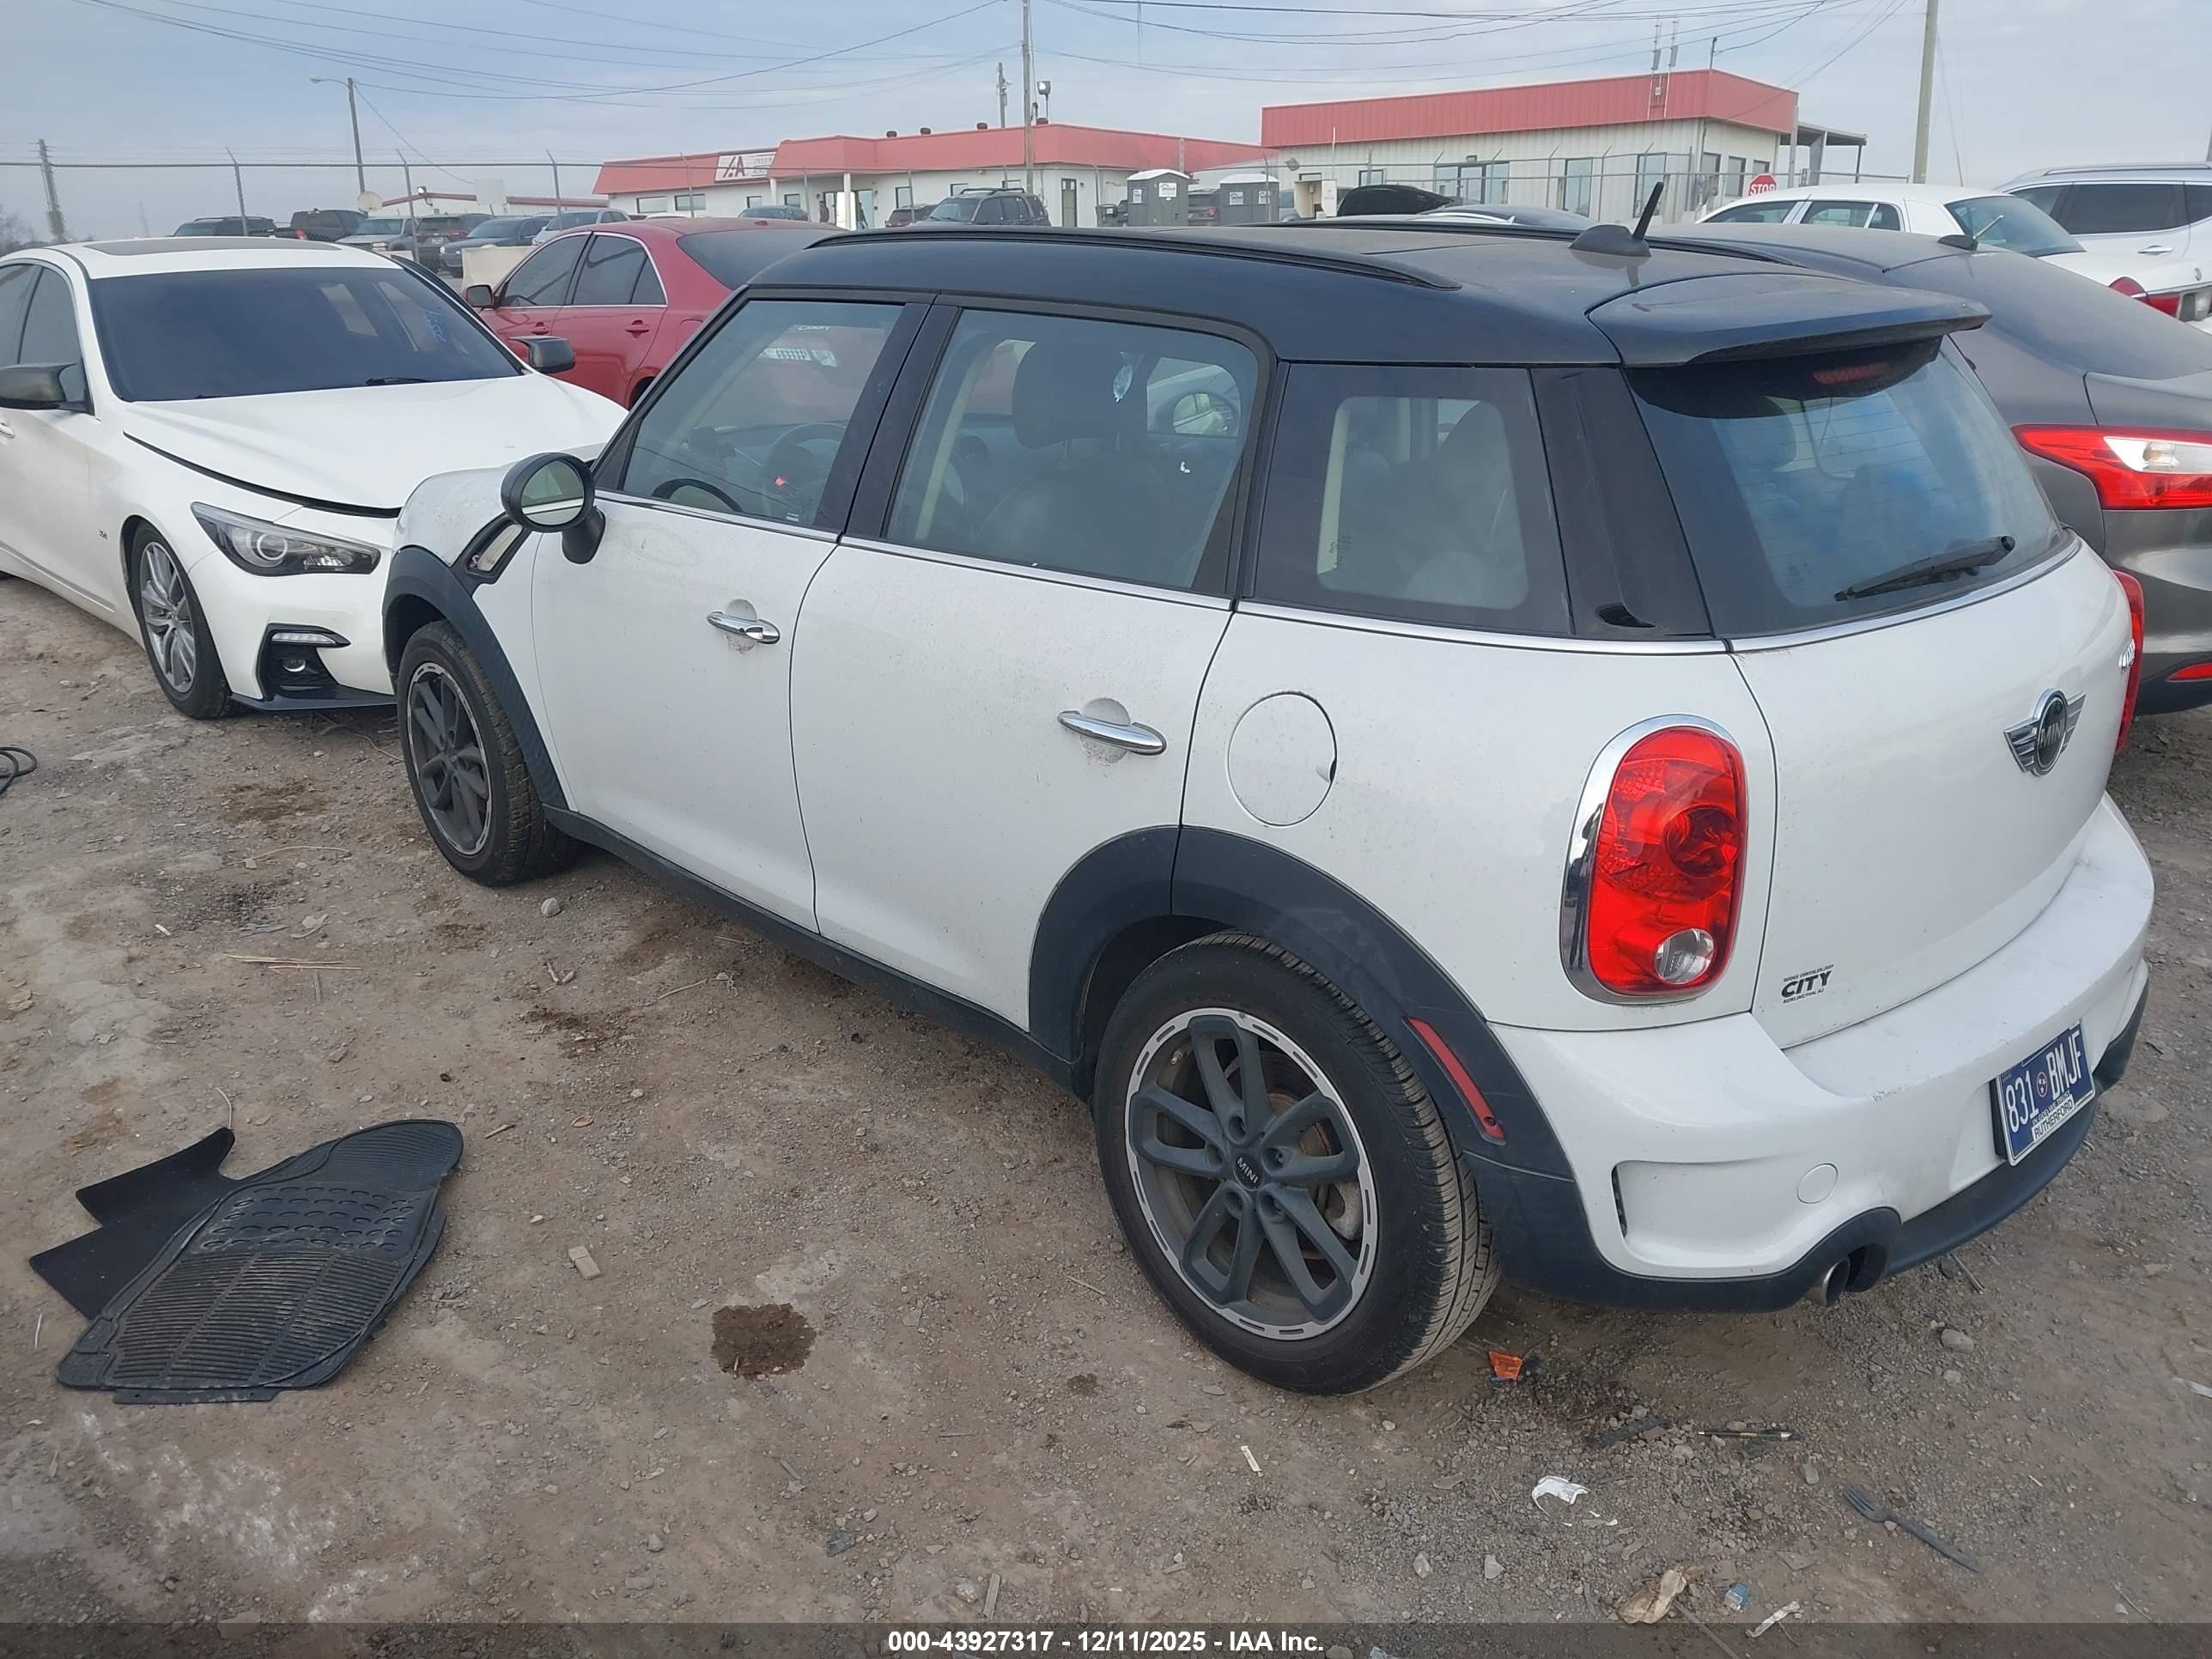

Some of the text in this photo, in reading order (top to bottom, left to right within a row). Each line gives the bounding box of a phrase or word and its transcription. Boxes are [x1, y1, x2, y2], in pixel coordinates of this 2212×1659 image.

[1750, 184, 1776, 195] STOP
[1782, 970, 1832, 998] CITY
[2005, 1030, 2081, 1133] 831 BMJF
[2033, 1098, 2074, 1139] RUTHERFORD
[1237, 1157, 1258, 1183] MINI
